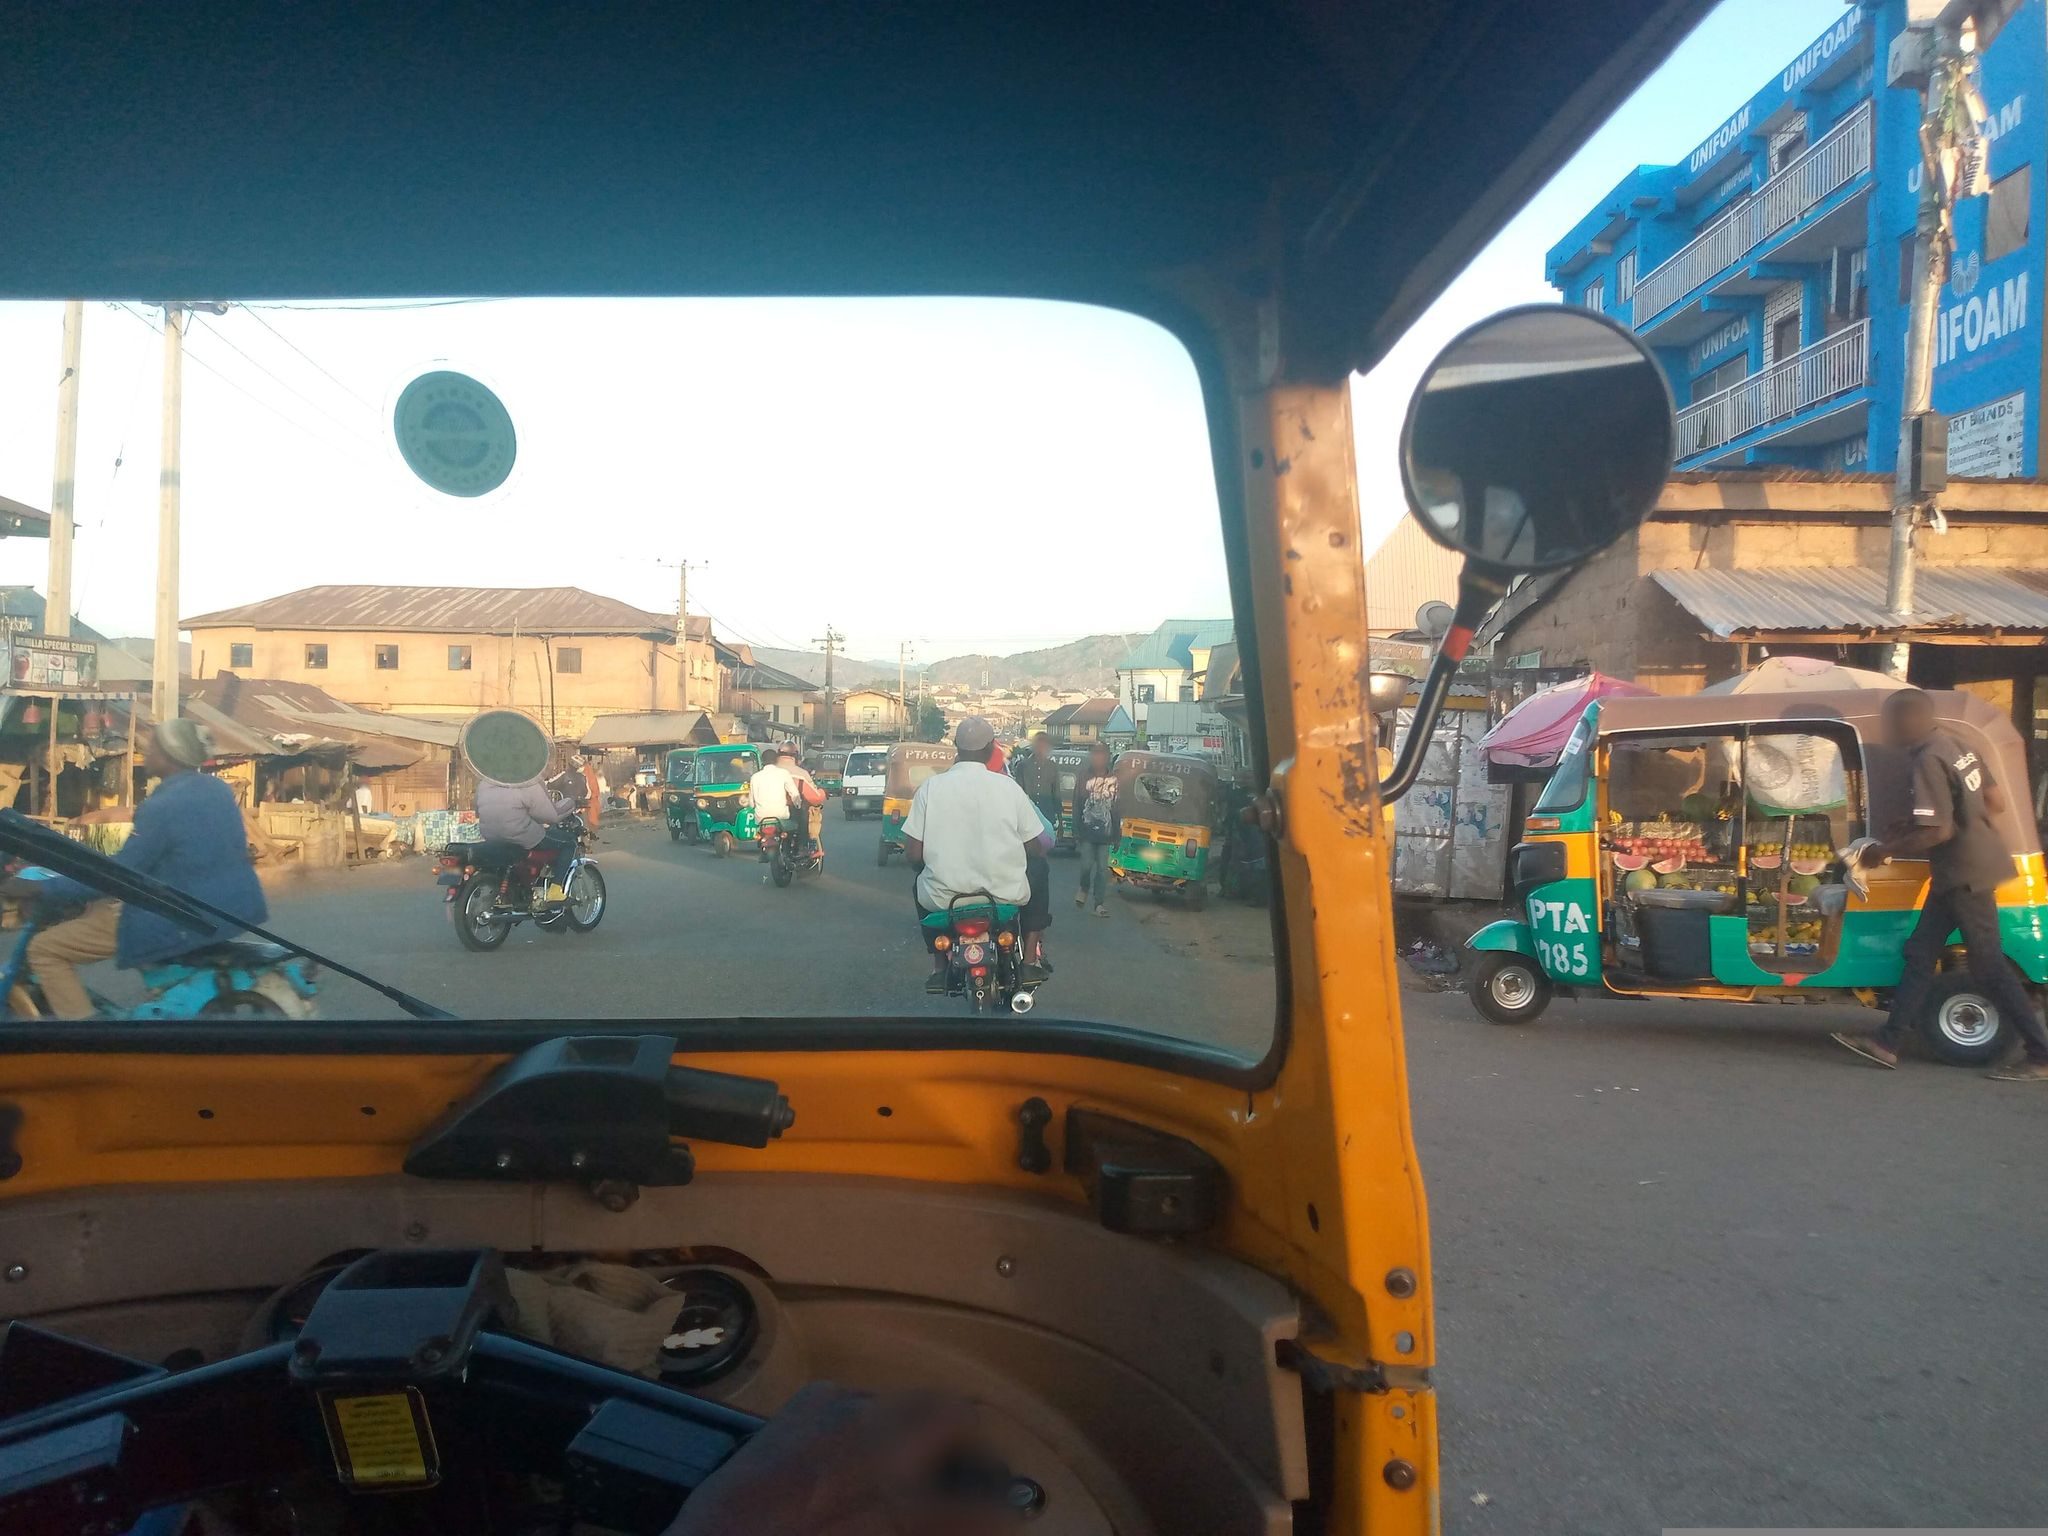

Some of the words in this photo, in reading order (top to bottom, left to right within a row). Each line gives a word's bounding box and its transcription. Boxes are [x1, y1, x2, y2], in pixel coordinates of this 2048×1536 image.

[1782, 6, 1862, 93] UNIFOAM
[1690, 105, 1749, 173] UNIFOAM
[905, 749, 929, 760] PTA
